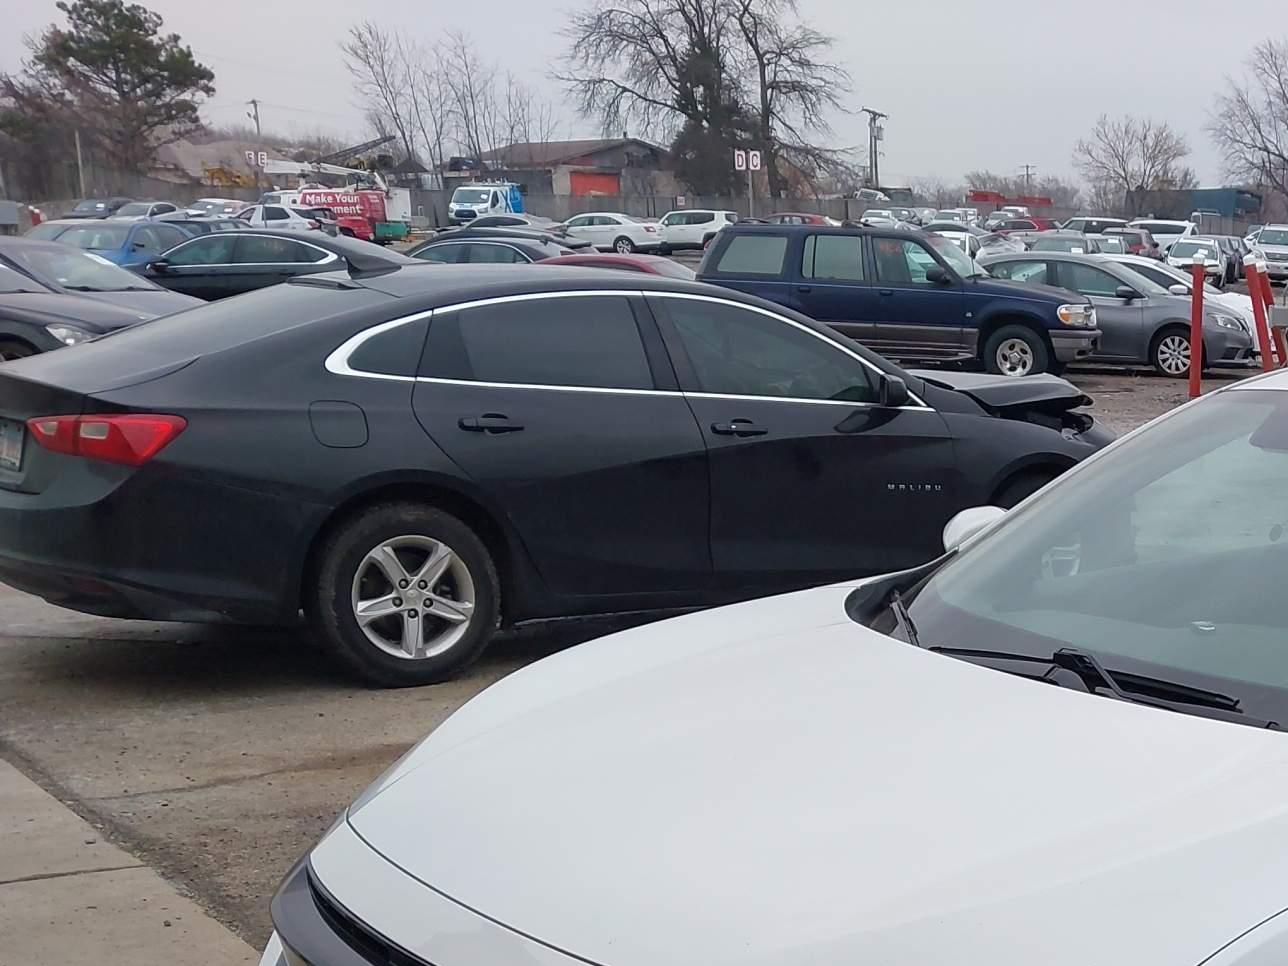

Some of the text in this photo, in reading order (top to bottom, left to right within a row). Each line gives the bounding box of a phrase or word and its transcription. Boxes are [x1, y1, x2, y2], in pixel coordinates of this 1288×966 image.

[736, 153, 744, 168] D
[751, 153, 759, 168] C
[305, 193, 332, 204] Make
[335, 193, 360, 203] Your
[887, 483, 941, 491] MALIBU
